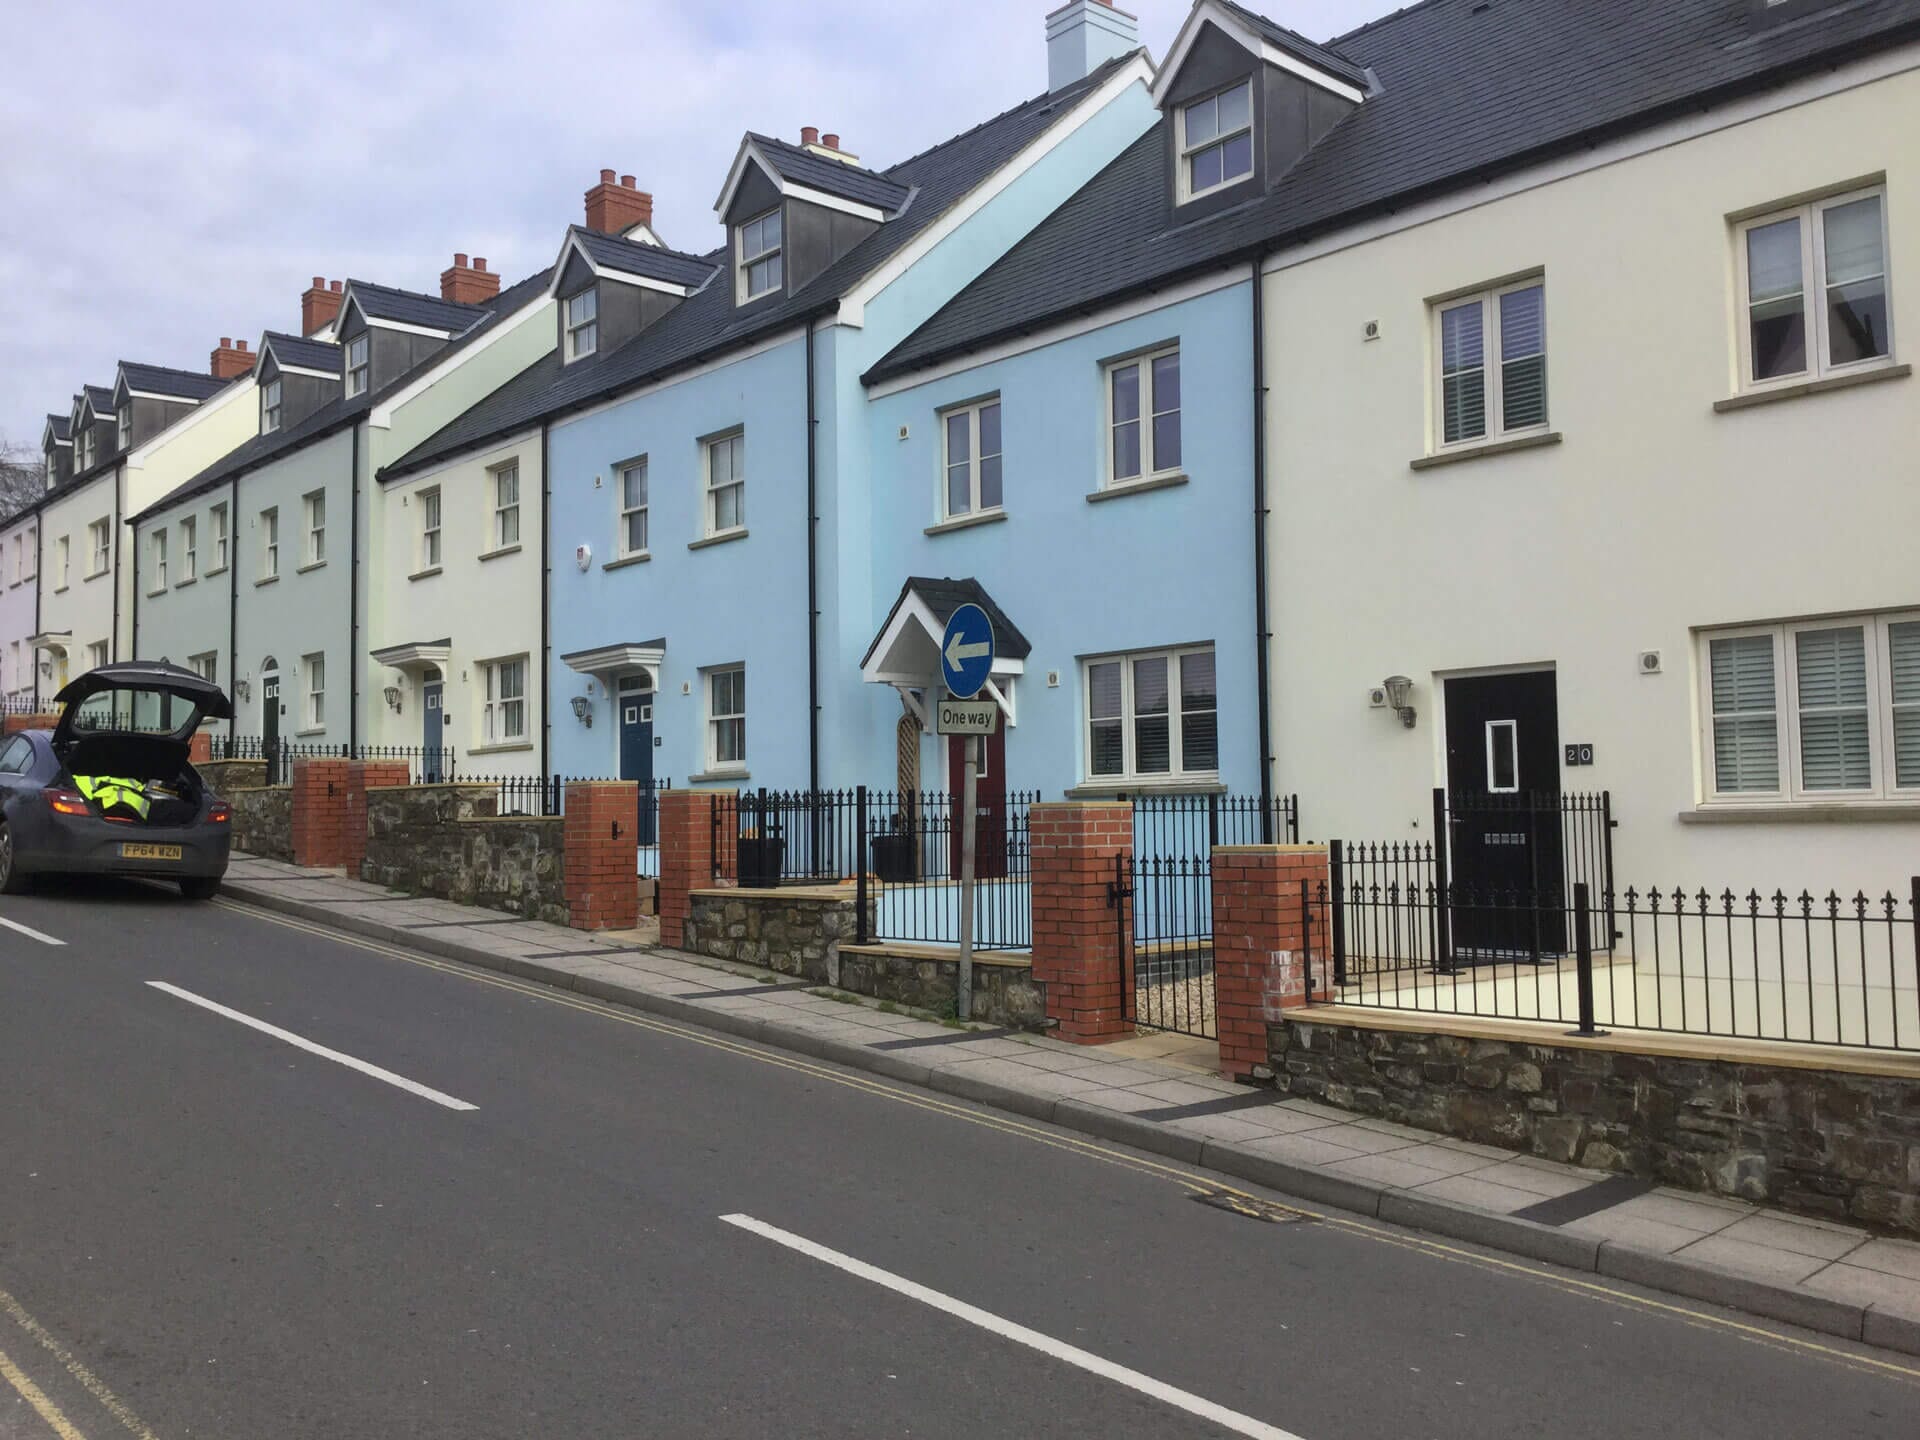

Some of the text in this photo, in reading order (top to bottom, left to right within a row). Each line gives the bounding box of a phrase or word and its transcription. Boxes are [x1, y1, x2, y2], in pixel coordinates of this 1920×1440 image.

[943, 709, 992, 728] One way
[1567, 748, 1591, 761] 20
[124, 844, 155, 856] FP64
